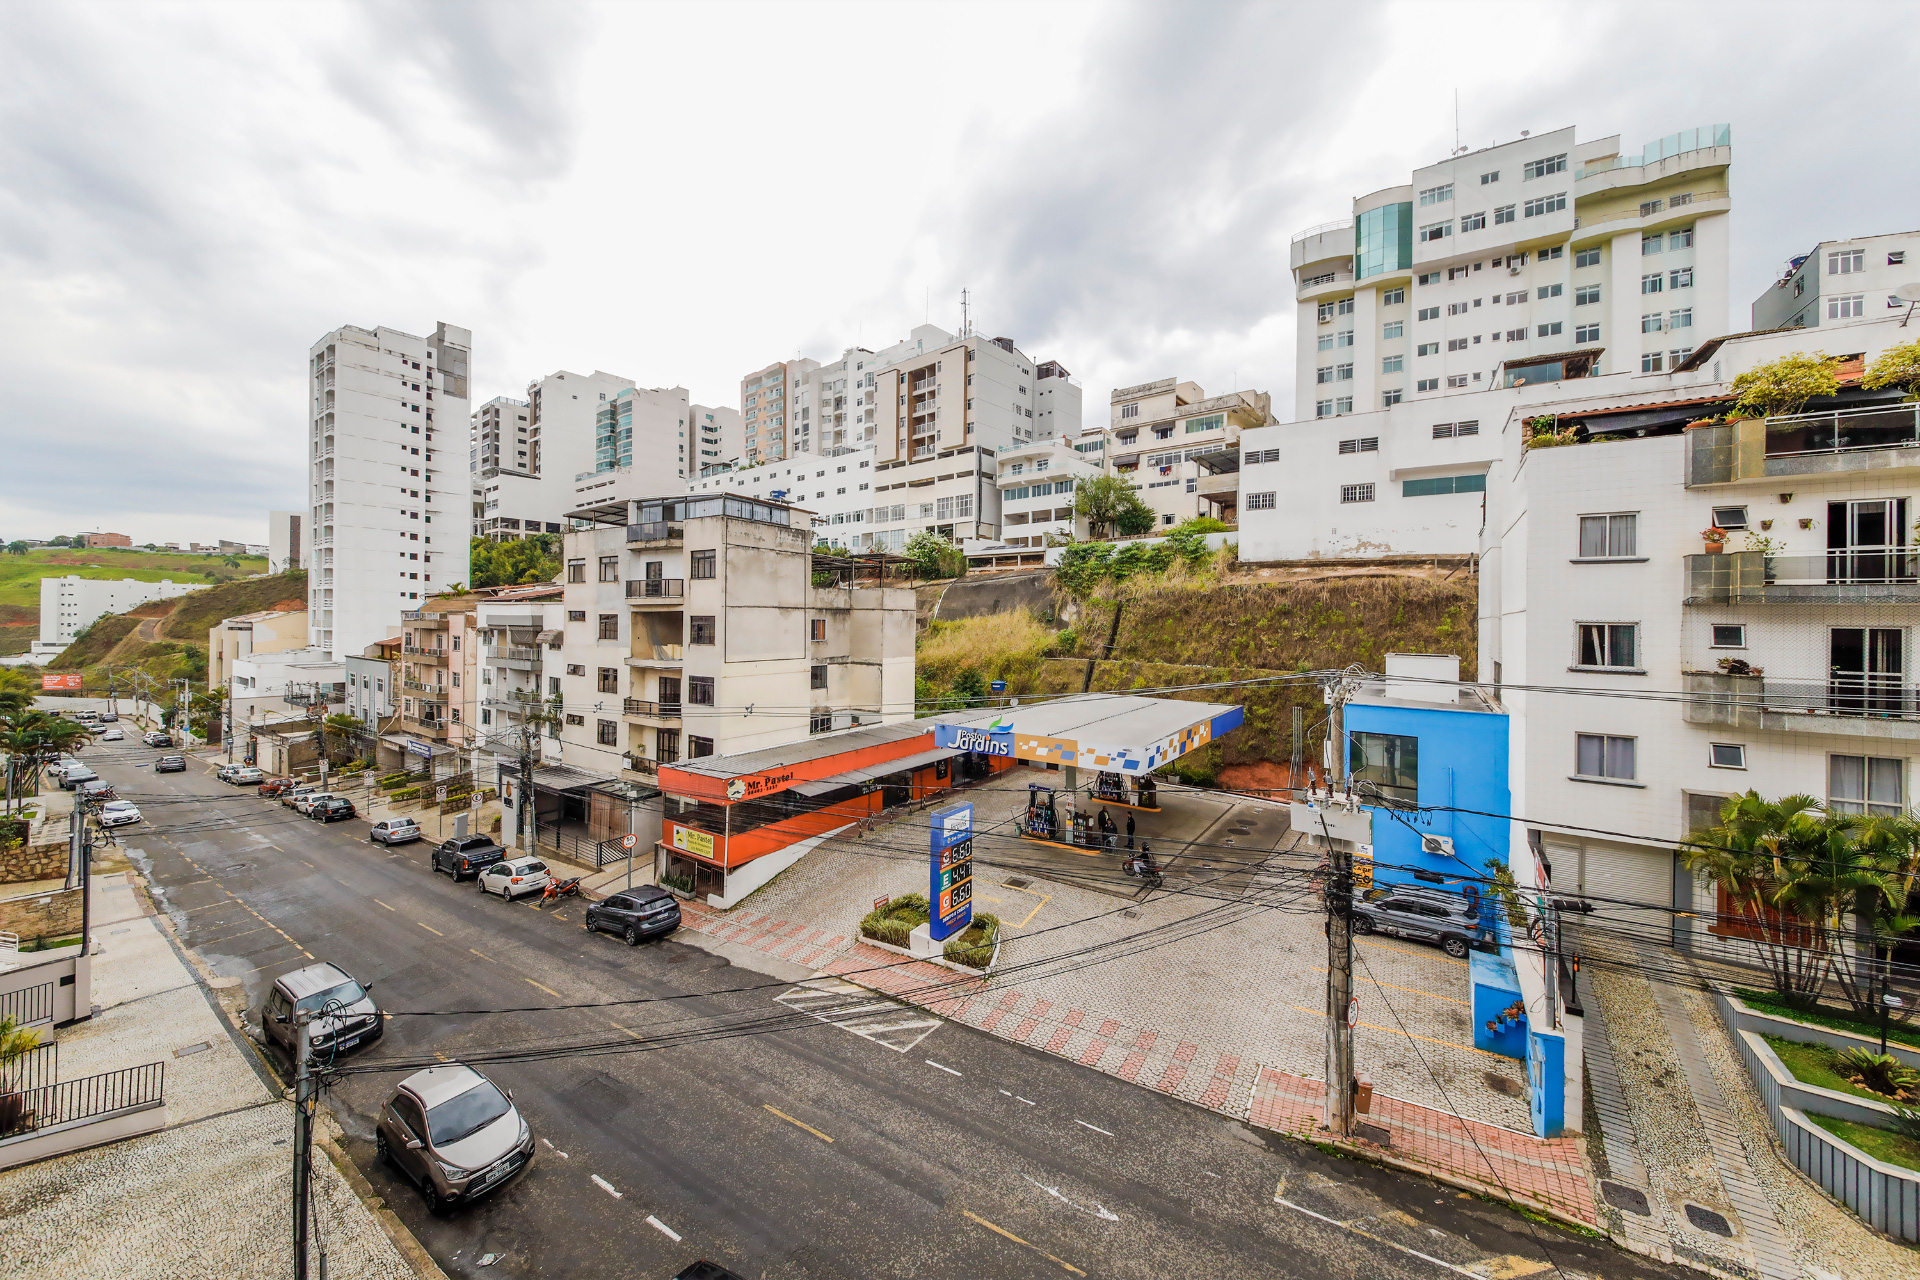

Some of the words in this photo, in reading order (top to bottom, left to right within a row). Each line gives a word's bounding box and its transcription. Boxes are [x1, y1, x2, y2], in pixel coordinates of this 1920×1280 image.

[962, 730, 982, 740] Posto
[948, 730, 1008, 755] Jardins
[748, 781, 763, 791] Mr.
[765, 772, 793, 787] Pastel
[943, 852, 950, 862] G
[943, 874, 949, 886] E
[943, 896, 950, 907] G
